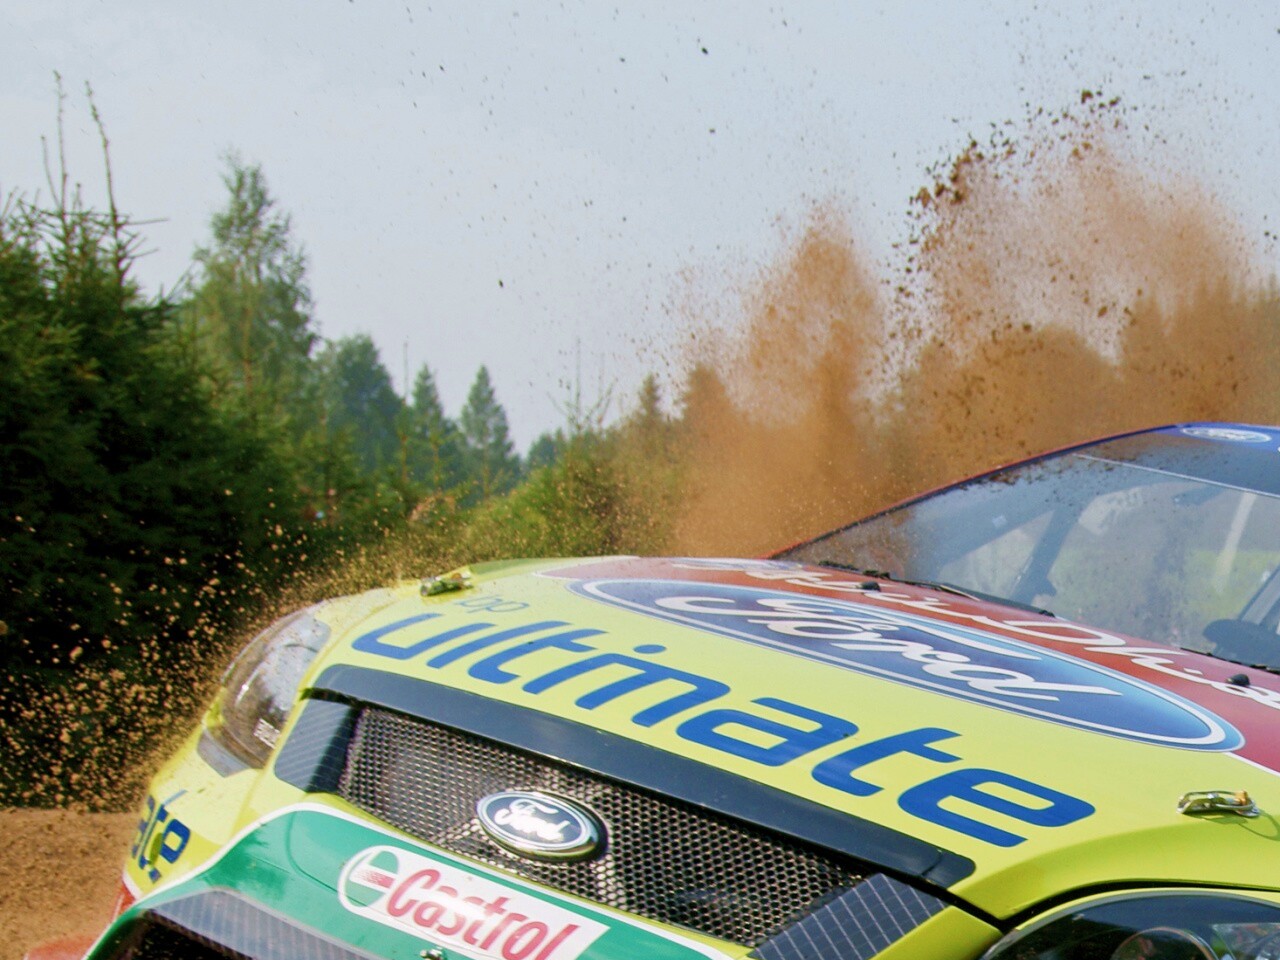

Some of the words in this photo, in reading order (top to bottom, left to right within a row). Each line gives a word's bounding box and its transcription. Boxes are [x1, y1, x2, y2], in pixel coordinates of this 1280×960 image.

[654, 595, 1123, 702] Ford
[351, 612, 1096, 848] ultimate
[494, 798, 571, 841] Ford
